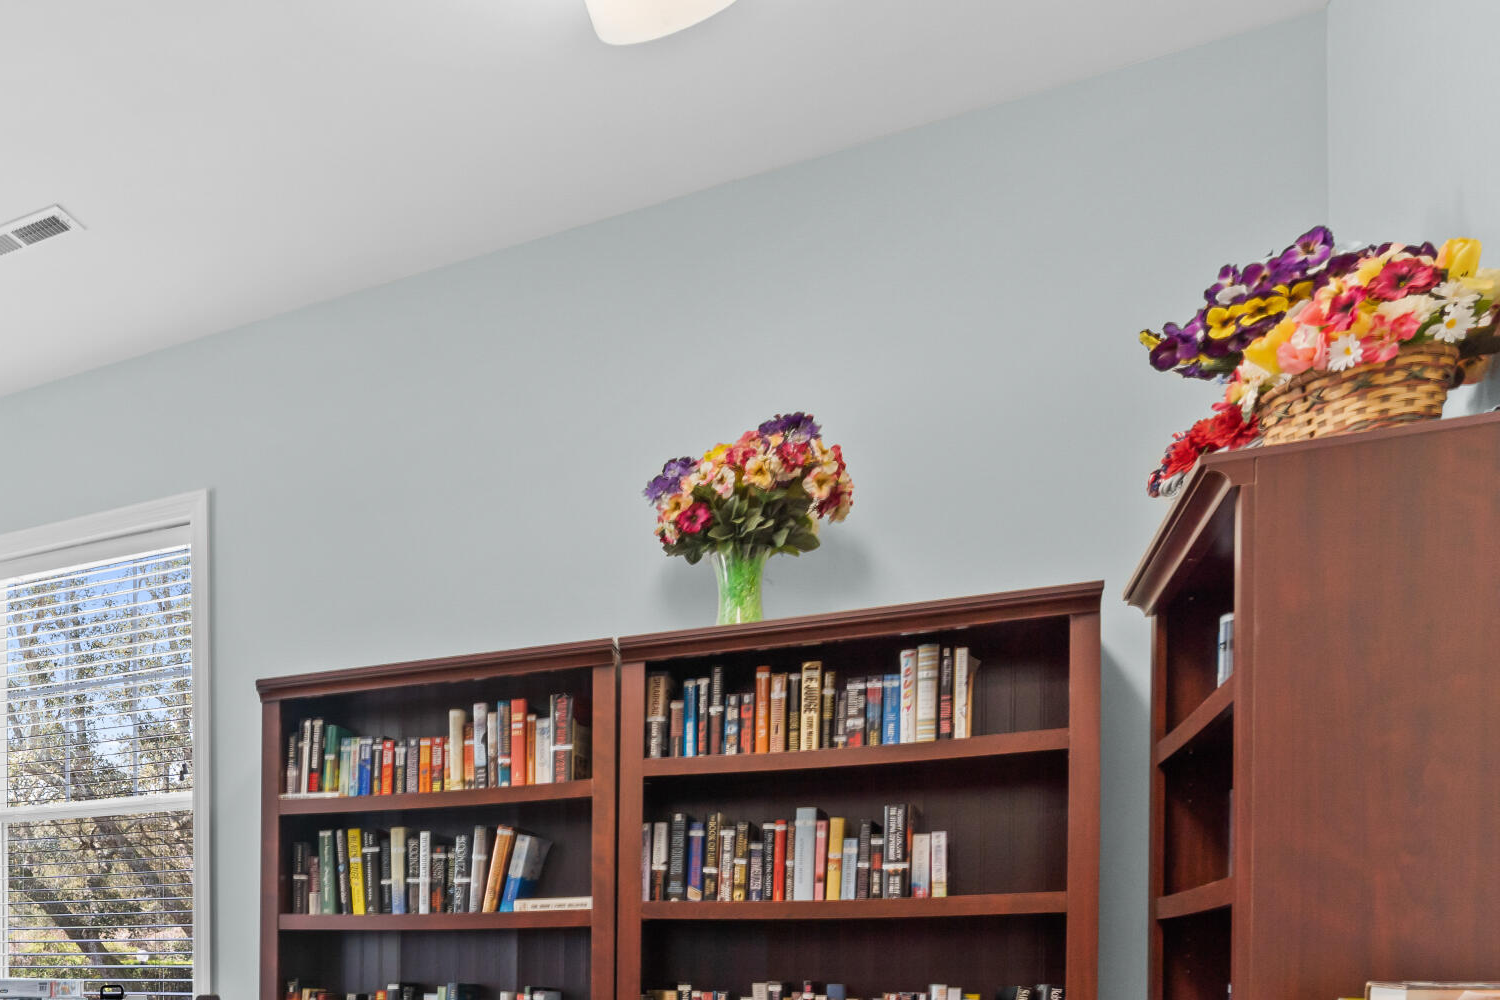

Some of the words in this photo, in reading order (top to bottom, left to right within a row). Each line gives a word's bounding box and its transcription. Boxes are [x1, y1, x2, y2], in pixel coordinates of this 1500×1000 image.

[651, 677, 662, 716] SPEARHEAD
[803, 684, 819, 714] JUDGE
[708, 820, 717, 840] BOOK
